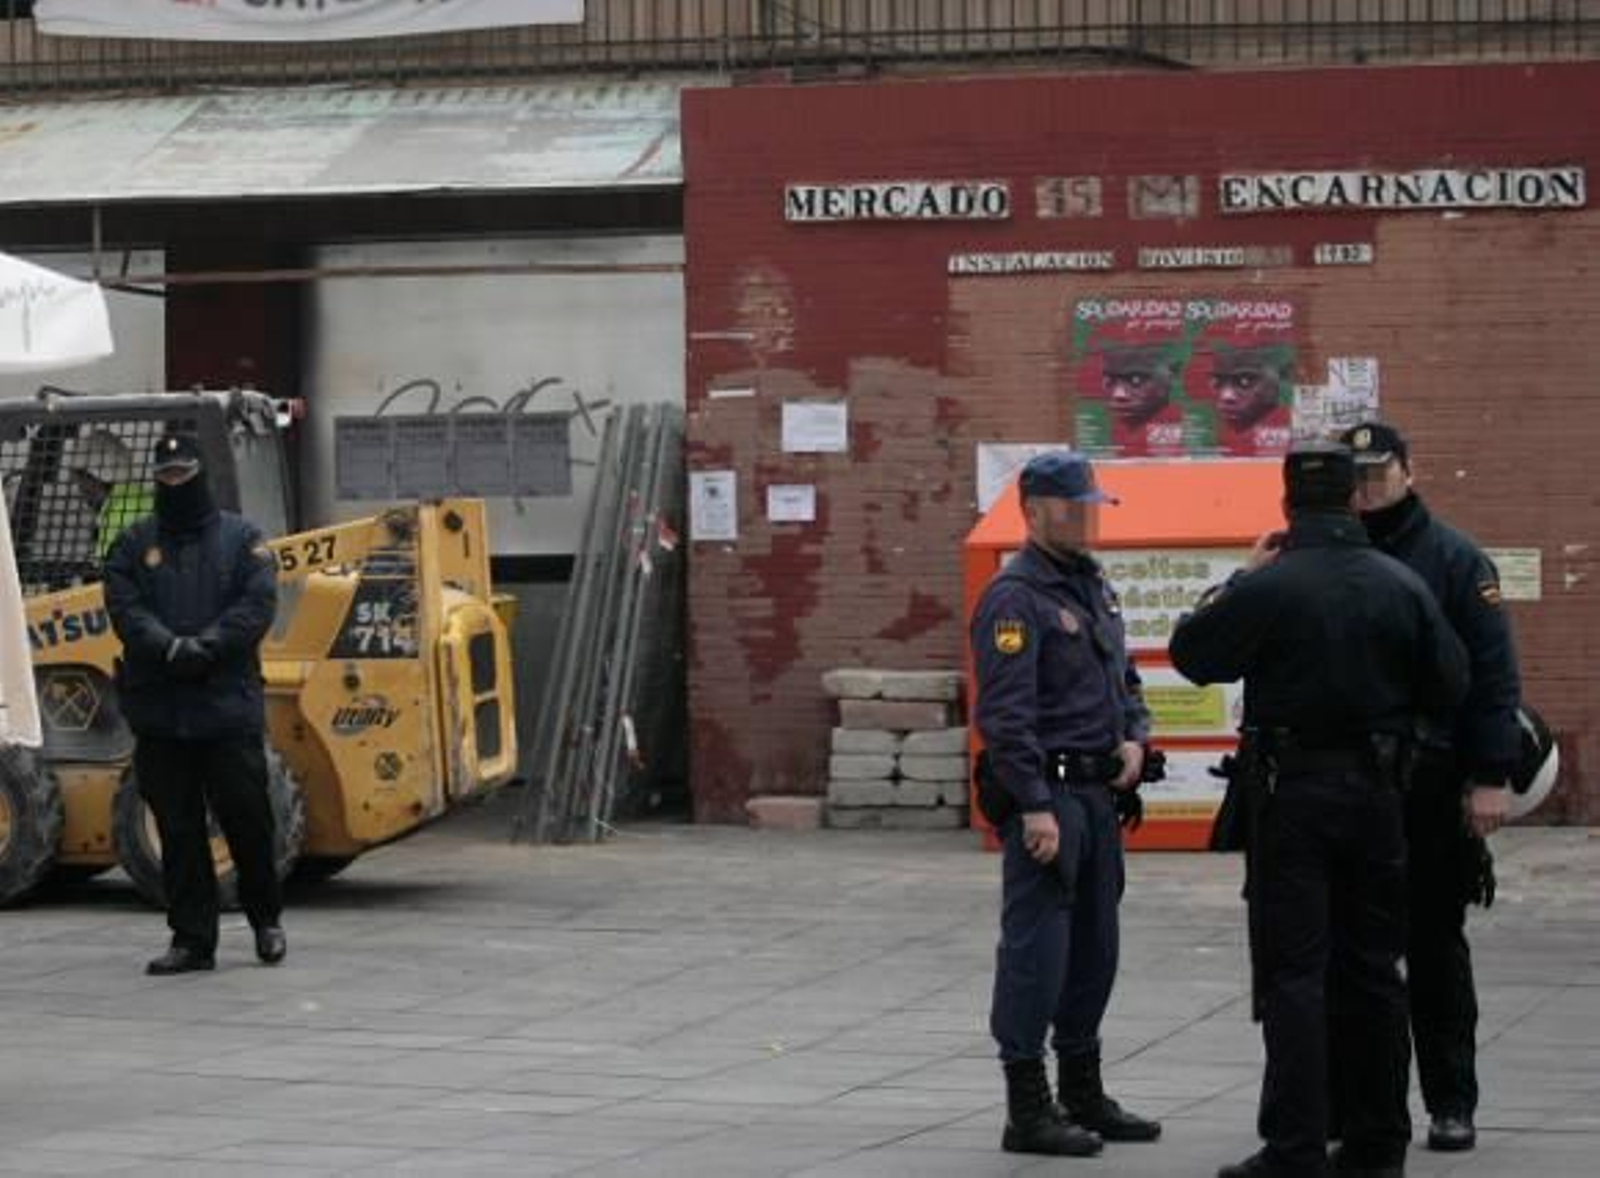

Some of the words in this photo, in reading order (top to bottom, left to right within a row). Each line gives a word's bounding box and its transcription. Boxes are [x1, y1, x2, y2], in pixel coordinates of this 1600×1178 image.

[786, 184, 1009, 219] MERCADO
[1222, 170, 1583, 209] ENCARNACION
[302, 534, 337, 565] 27
